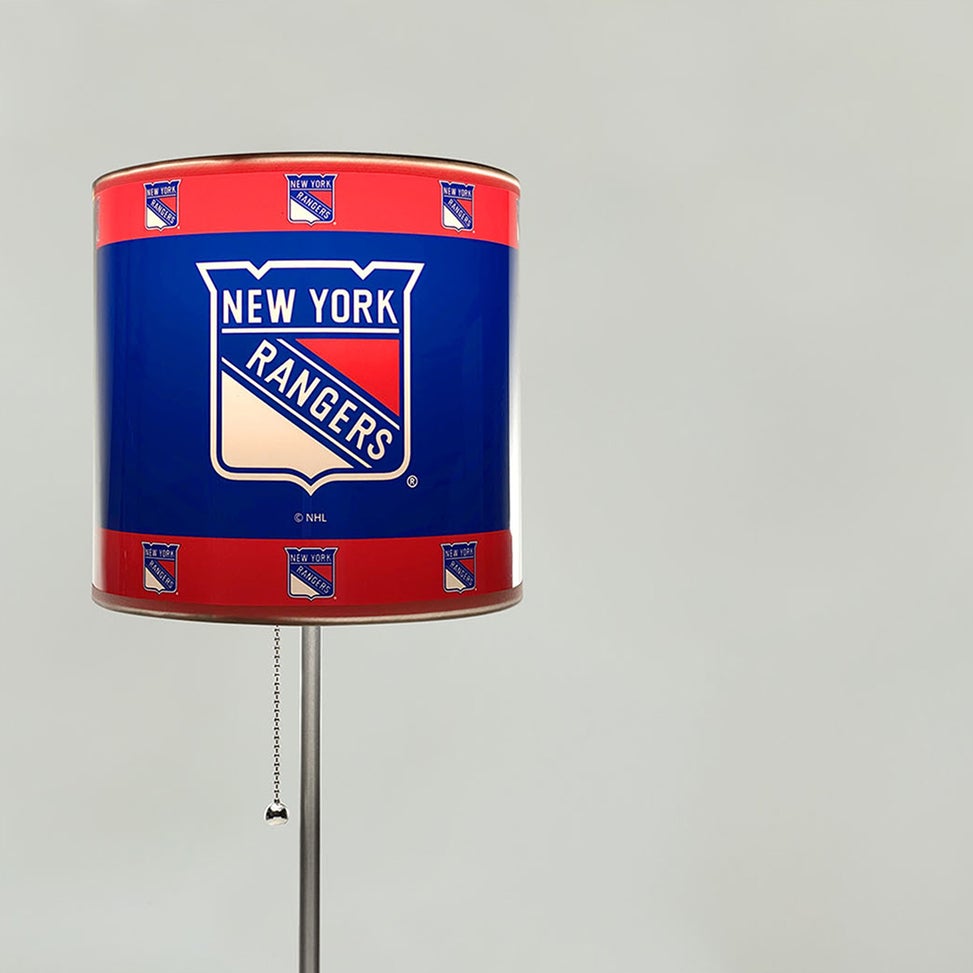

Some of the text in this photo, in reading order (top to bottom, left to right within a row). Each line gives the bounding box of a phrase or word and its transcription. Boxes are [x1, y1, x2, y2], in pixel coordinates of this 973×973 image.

[290, 180, 332, 188] NEW YORK
[296, 191, 331, 219] RANGERS
[223, 288, 398, 324] NEW YORK
[245, 339, 393, 460] RANGERS
[305, 513, 327, 522] NHL
[290, 554, 332, 562] NEW YORK
[296, 566, 331, 594] RANGERS
